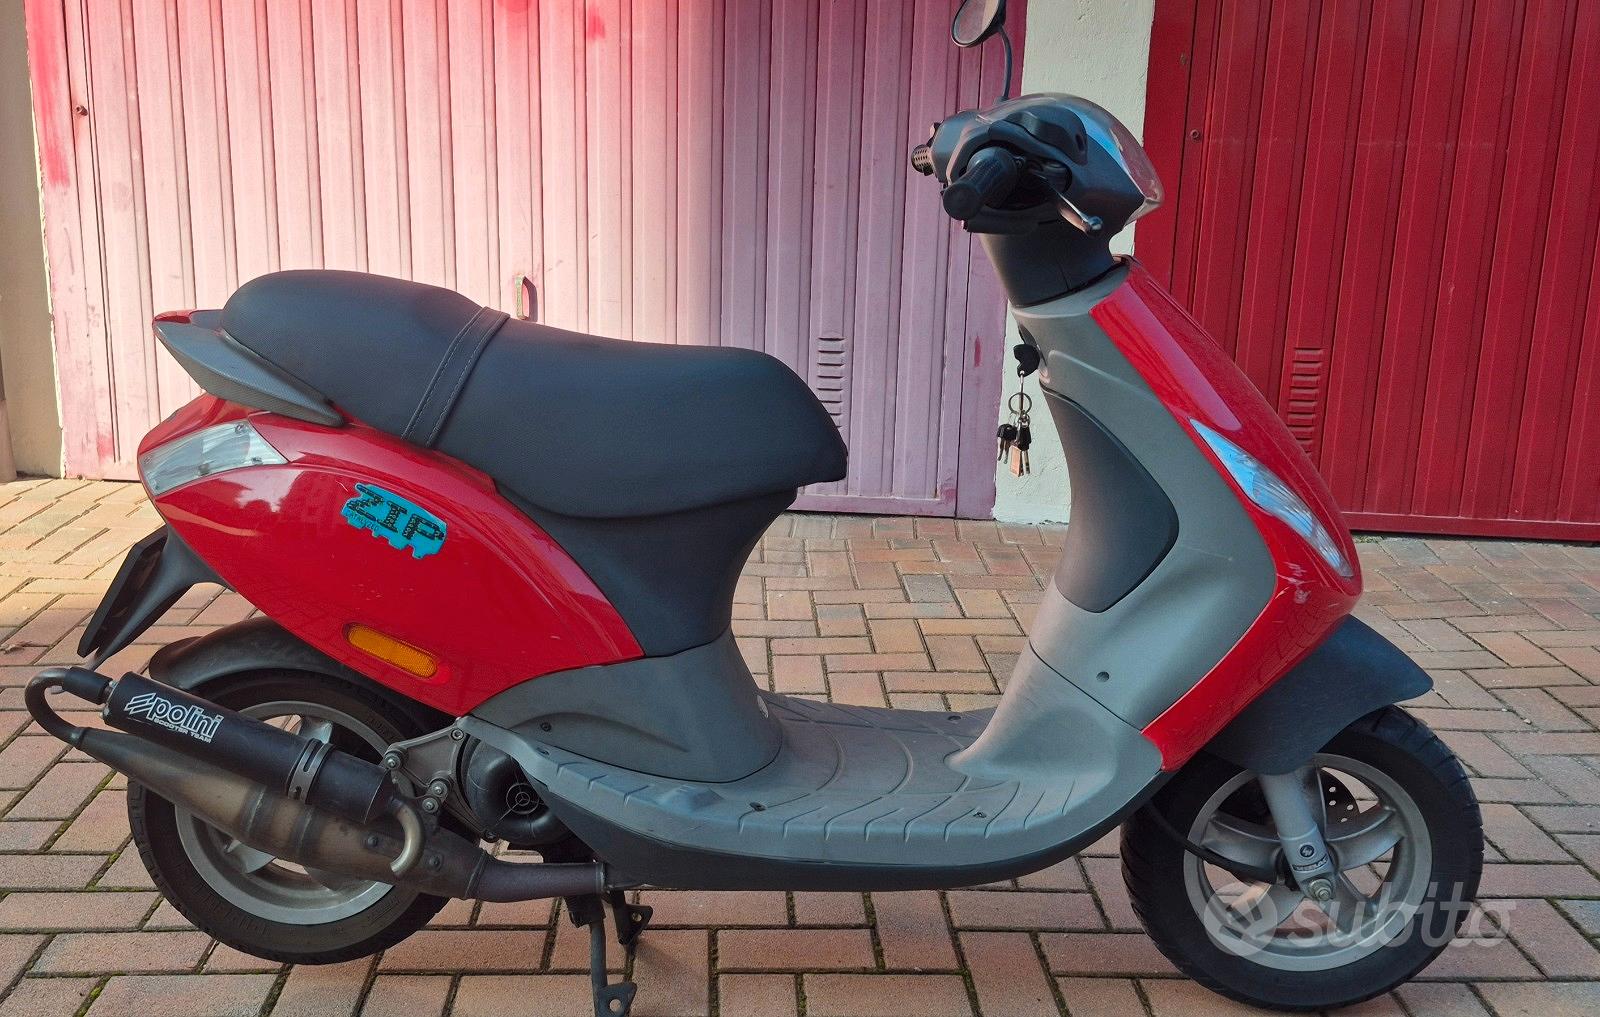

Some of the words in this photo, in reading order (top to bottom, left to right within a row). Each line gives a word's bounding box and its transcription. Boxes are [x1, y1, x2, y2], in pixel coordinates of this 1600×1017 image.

[346, 484, 445, 541] ZIP
[146, 697, 224, 738] polini
[153, 718, 188, 735] SCOOTER
[190, 731, 212, 743] TEAM
